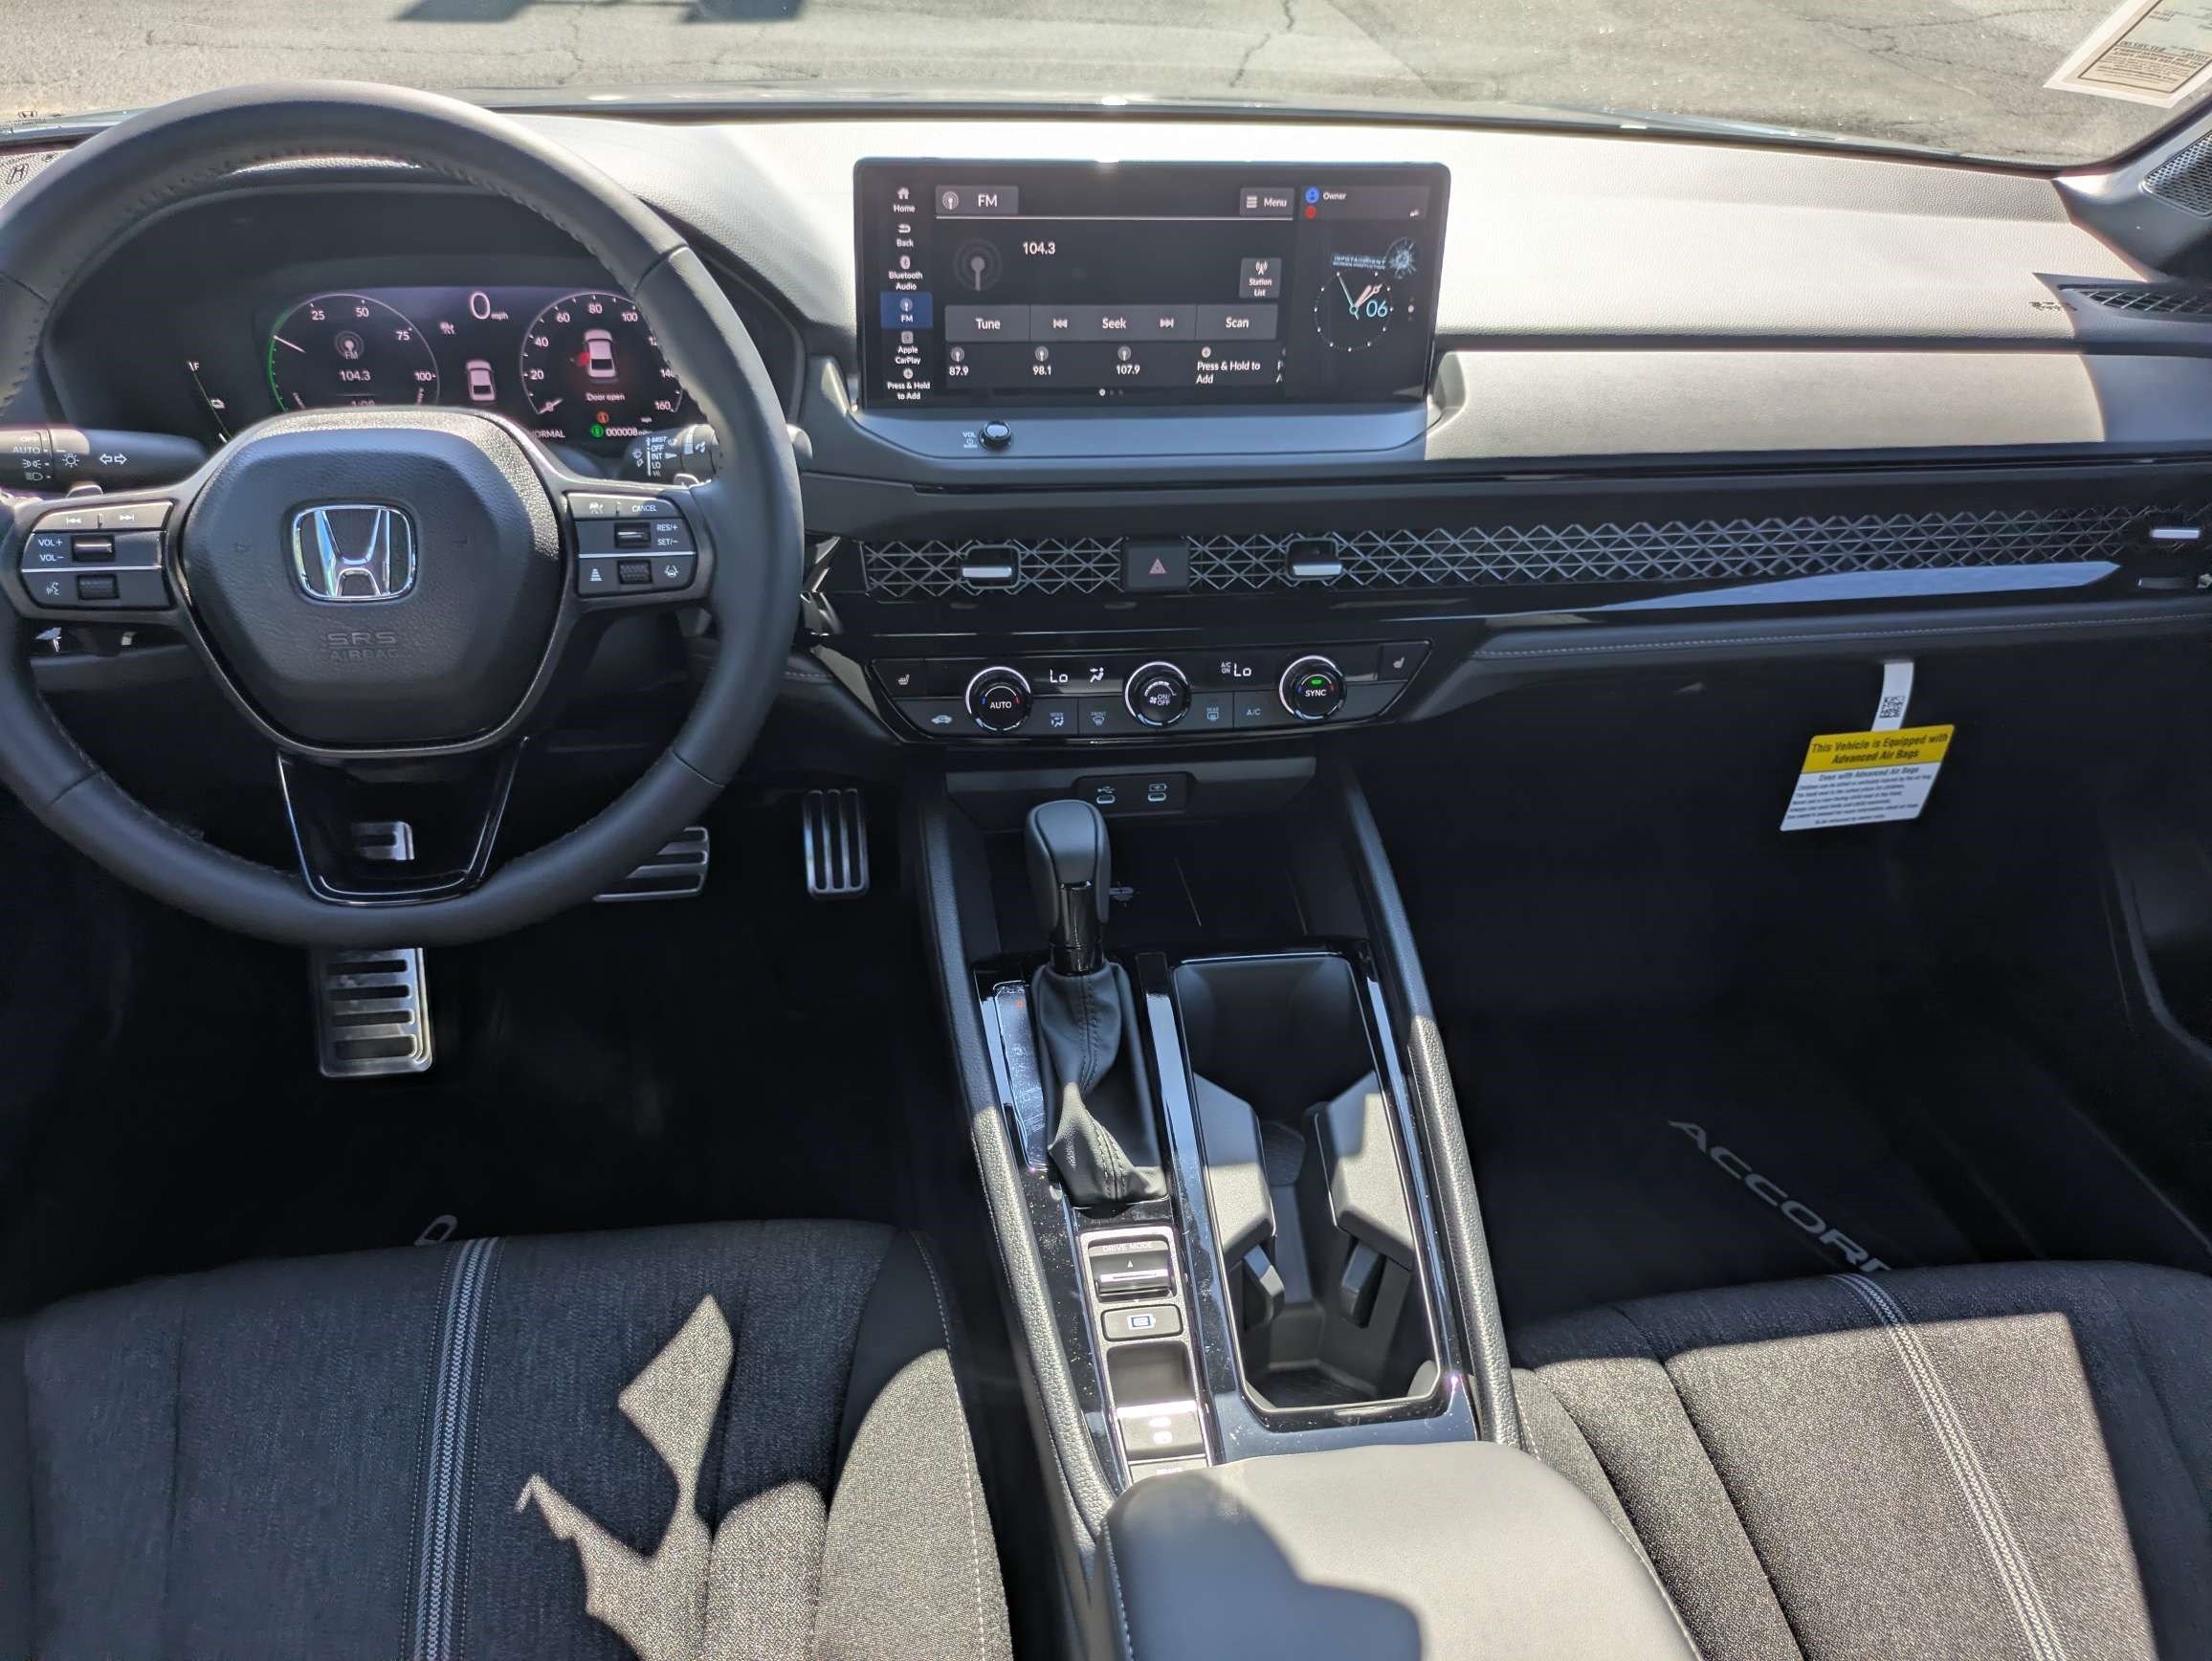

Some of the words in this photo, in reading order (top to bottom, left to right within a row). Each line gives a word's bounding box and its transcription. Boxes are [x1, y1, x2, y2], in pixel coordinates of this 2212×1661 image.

[978, 194, 998, 208] FM
[1323, 192, 1346, 201] Owner
[1264, 197, 1287, 207] Menu
[894, 204, 915, 212] Home
[1023, 242, 1056, 255] 104.3
[889, 271, 922, 279] Bluetooth
[896, 282, 917, 291] Audio
[1249, 278, 1272, 287] Station
[470, 293, 491, 320] 0
[491, 312, 509, 321] mph
[588, 303, 603, 314] 80
[1365, 300, 1388, 318] 06
[311, 311, 325, 321] 25
[355, 307, 369, 318] 50
[557, 312, 570, 323] 60
[622, 312, 638, 321] 100
[901, 315, 913, 323] FM
[976, 318, 1001, 329] Tune
[1102, 318, 1127, 329] Seek
[1226, 318, 1250, 328] Scan
[396, 331, 409, 341] 75
[535, 337, 549, 347] 40
[345, 351, 358, 360] FM
[897, 346, 918, 355] Apple
[895, 356, 920, 365] CarPlay
[949, 365, 969, 376] 87.9
[1032, 365, 1052, 376] 98.1
[1116, 365, 1140, 375] 107.9
[1197, 362, 1219, 371] Press
[1221, 362, 1228, 371] &
[1229, 362, 1250, 371] Hold
[1251, 362, 1261, 370] to
[340, 370, 371, 381] 104.3
[414, 372, 432, 381] 100
[530, 369, 544, 381] 20
[1196, 374, 1213, 384] Add
[887, 382, 905, 390] Press
[906, 382, 913, 390] &
[914, 382, 930, 390] Hold
[586, 392, 606, 401] Door
[607, 393, 626, 402] open
[654, 401, 672, 410] 160
[533, 430, 566, 438] ORMAL
[631, 504, 658, 513] CANCEL
[656, 523, 678, 532] RES/+
[328, 631, 397, 645] SRS
[1233, 662, 1251, 677] Lo
[1050, 669, 1069, 683] Lo
[1305, 689, 1326, 698] SYNC
[989, 700, 1012, 710] AUTO
[1812, 742, 1832, 753] This
[1835, 741, 1869, 752] Vehicle
[1873, 740, 1882, 748] is
[1883, 735, 1926, 748] Equipped
[1928, 734, 1949, 743] with
[1831, 752, 1878, 764] Advanced
[1878, 750, 1894, 760] Air
[1895, 749, 1920, 760] Bags
[1102, 1242, 1127, 1252] DRIVE
